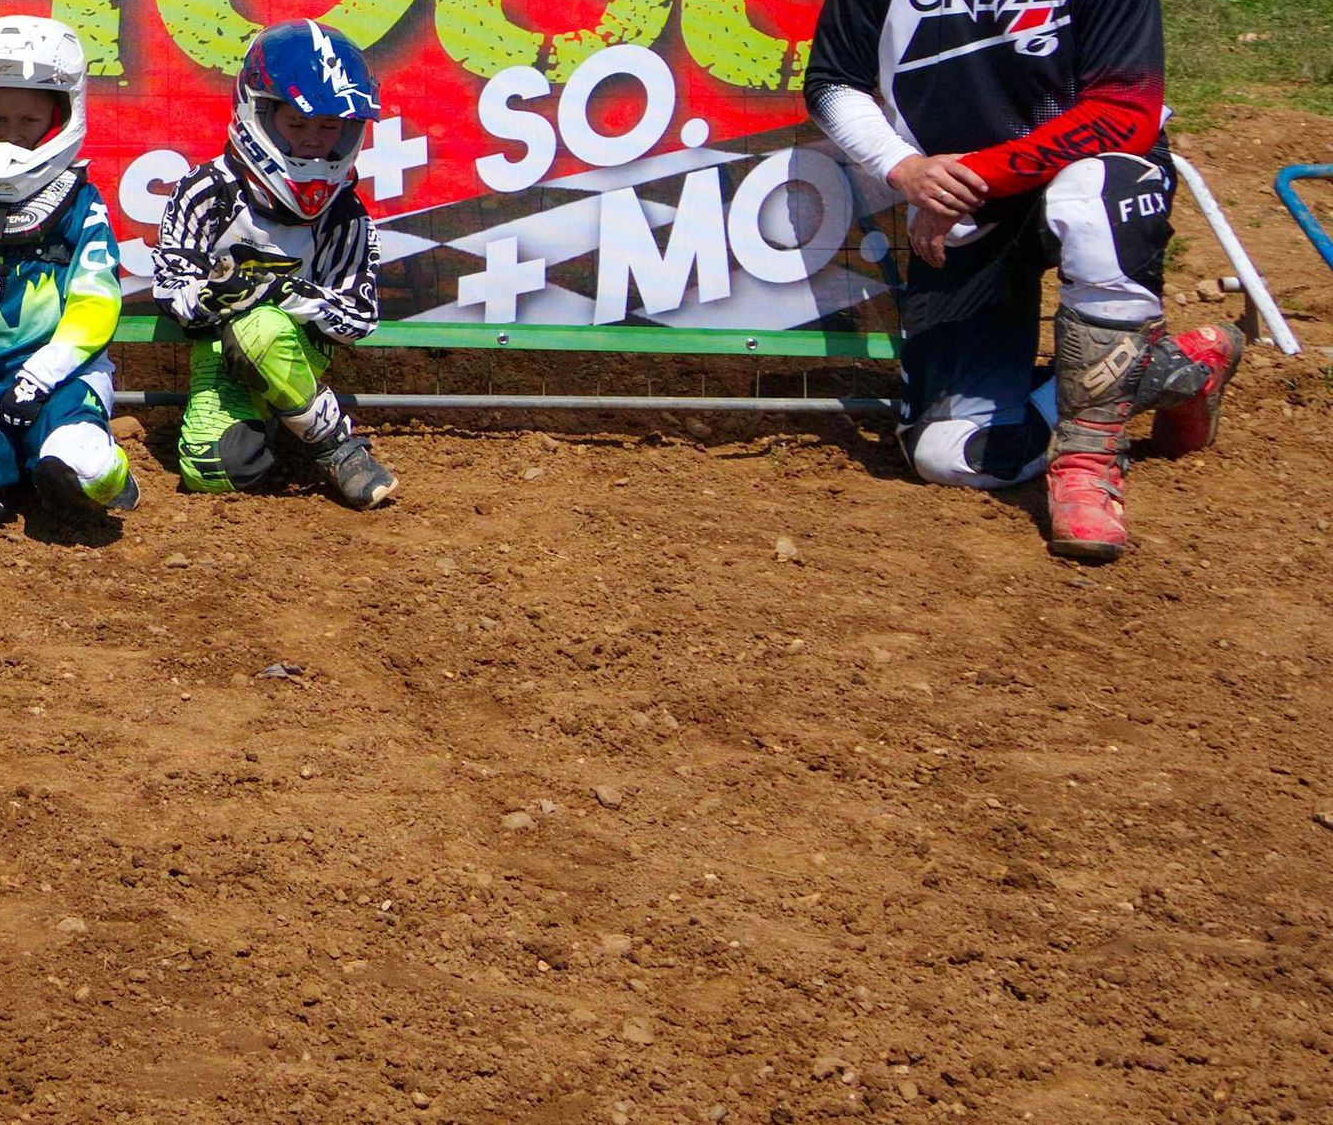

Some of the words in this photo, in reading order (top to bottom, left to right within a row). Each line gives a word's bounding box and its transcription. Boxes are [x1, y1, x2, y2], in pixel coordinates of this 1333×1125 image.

[476, 42, 711, 192] SO.
[594, 147, 890, 325] MO.
[1117, 191, 1168, 223] FOX
